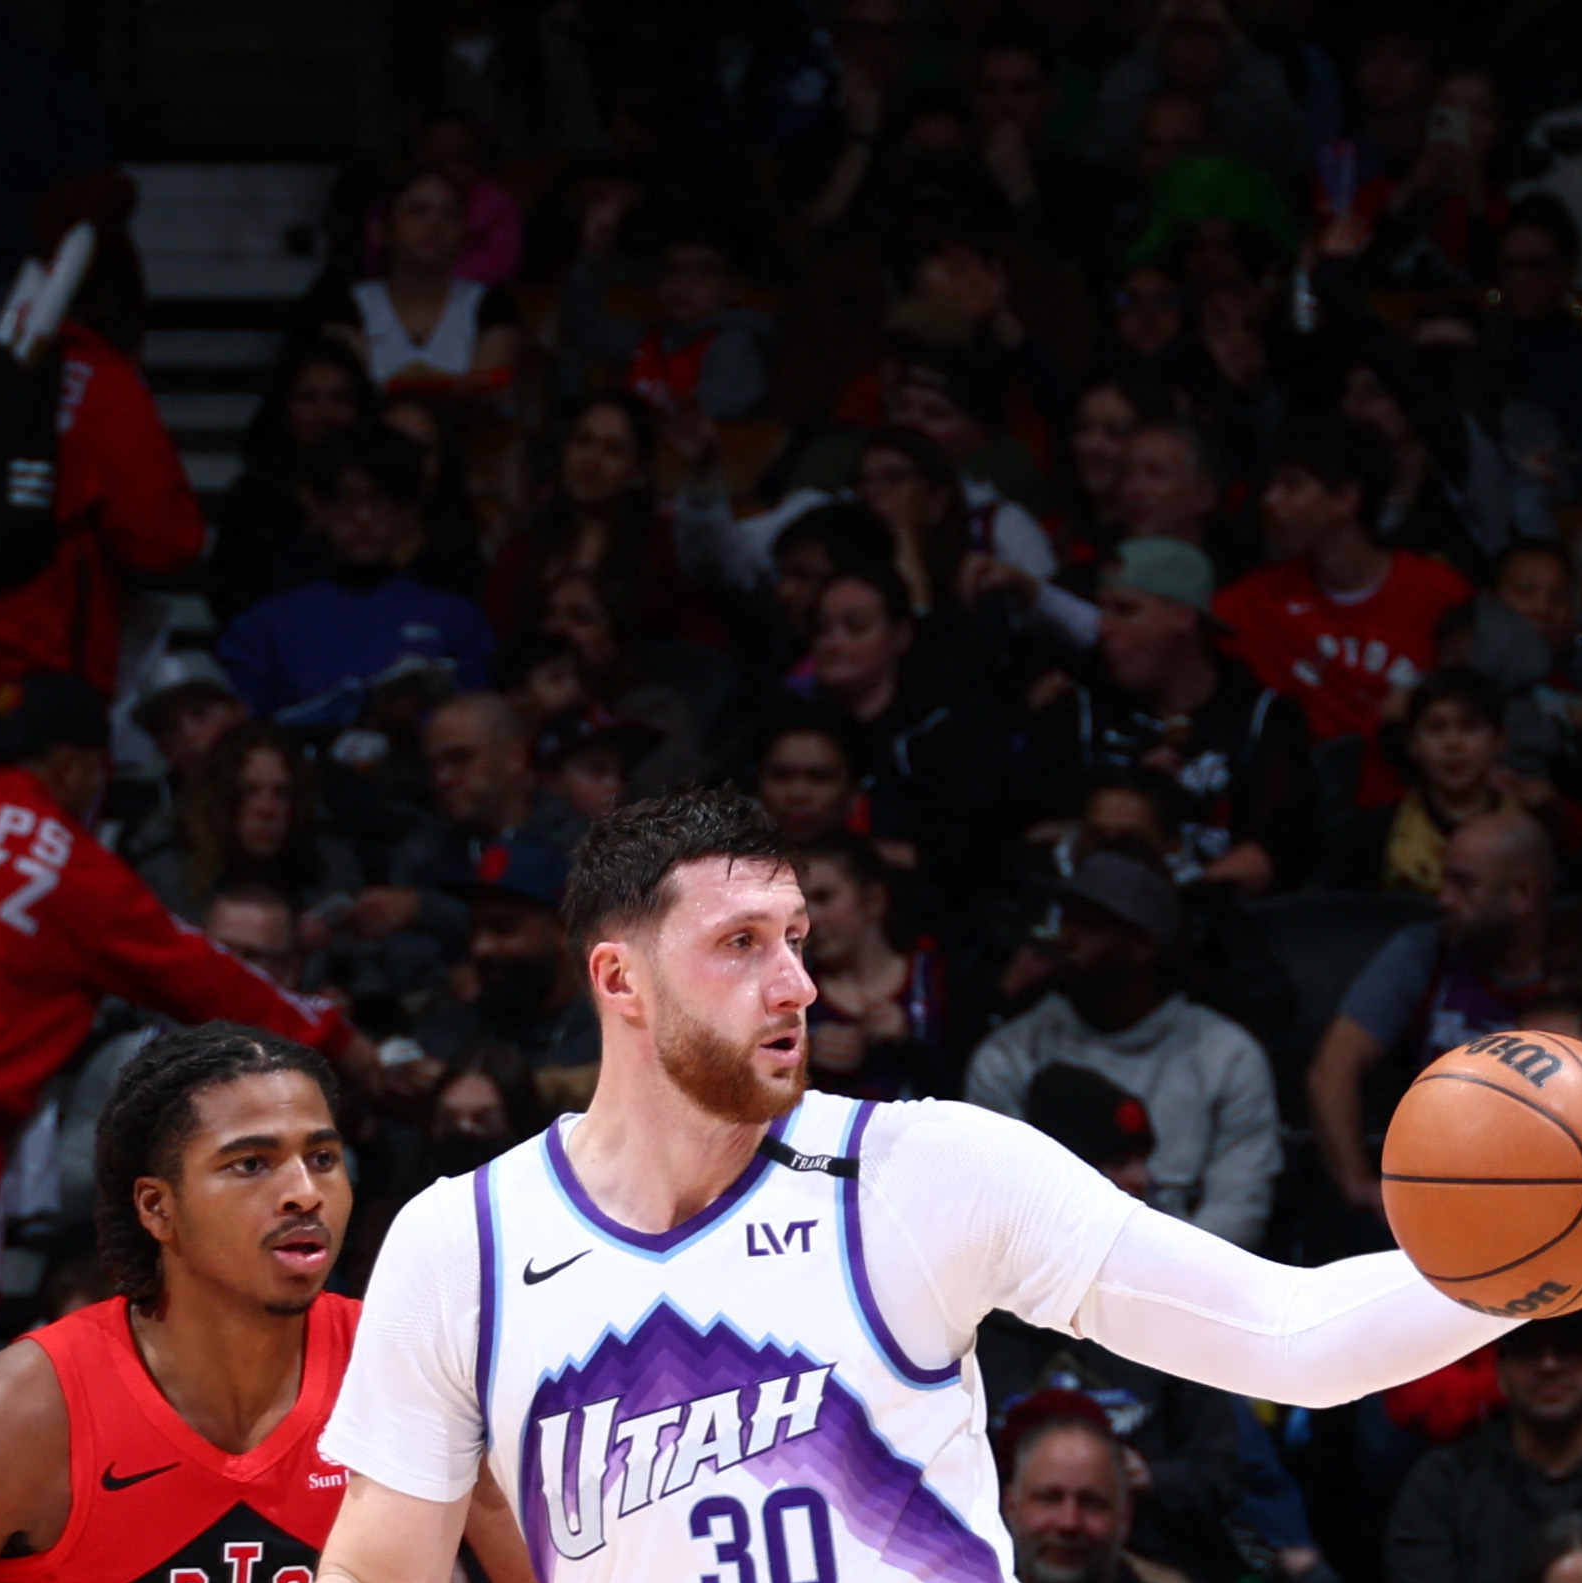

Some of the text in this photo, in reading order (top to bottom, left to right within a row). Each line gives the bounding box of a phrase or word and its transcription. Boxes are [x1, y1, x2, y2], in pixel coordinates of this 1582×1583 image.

[790, 1153, 833, 1171] FRANK
[745, 1219, 821, 1257] LVT
[536, 1361, 839, 1561] UTAH
[308, 1472, 343, 1490] Sun
